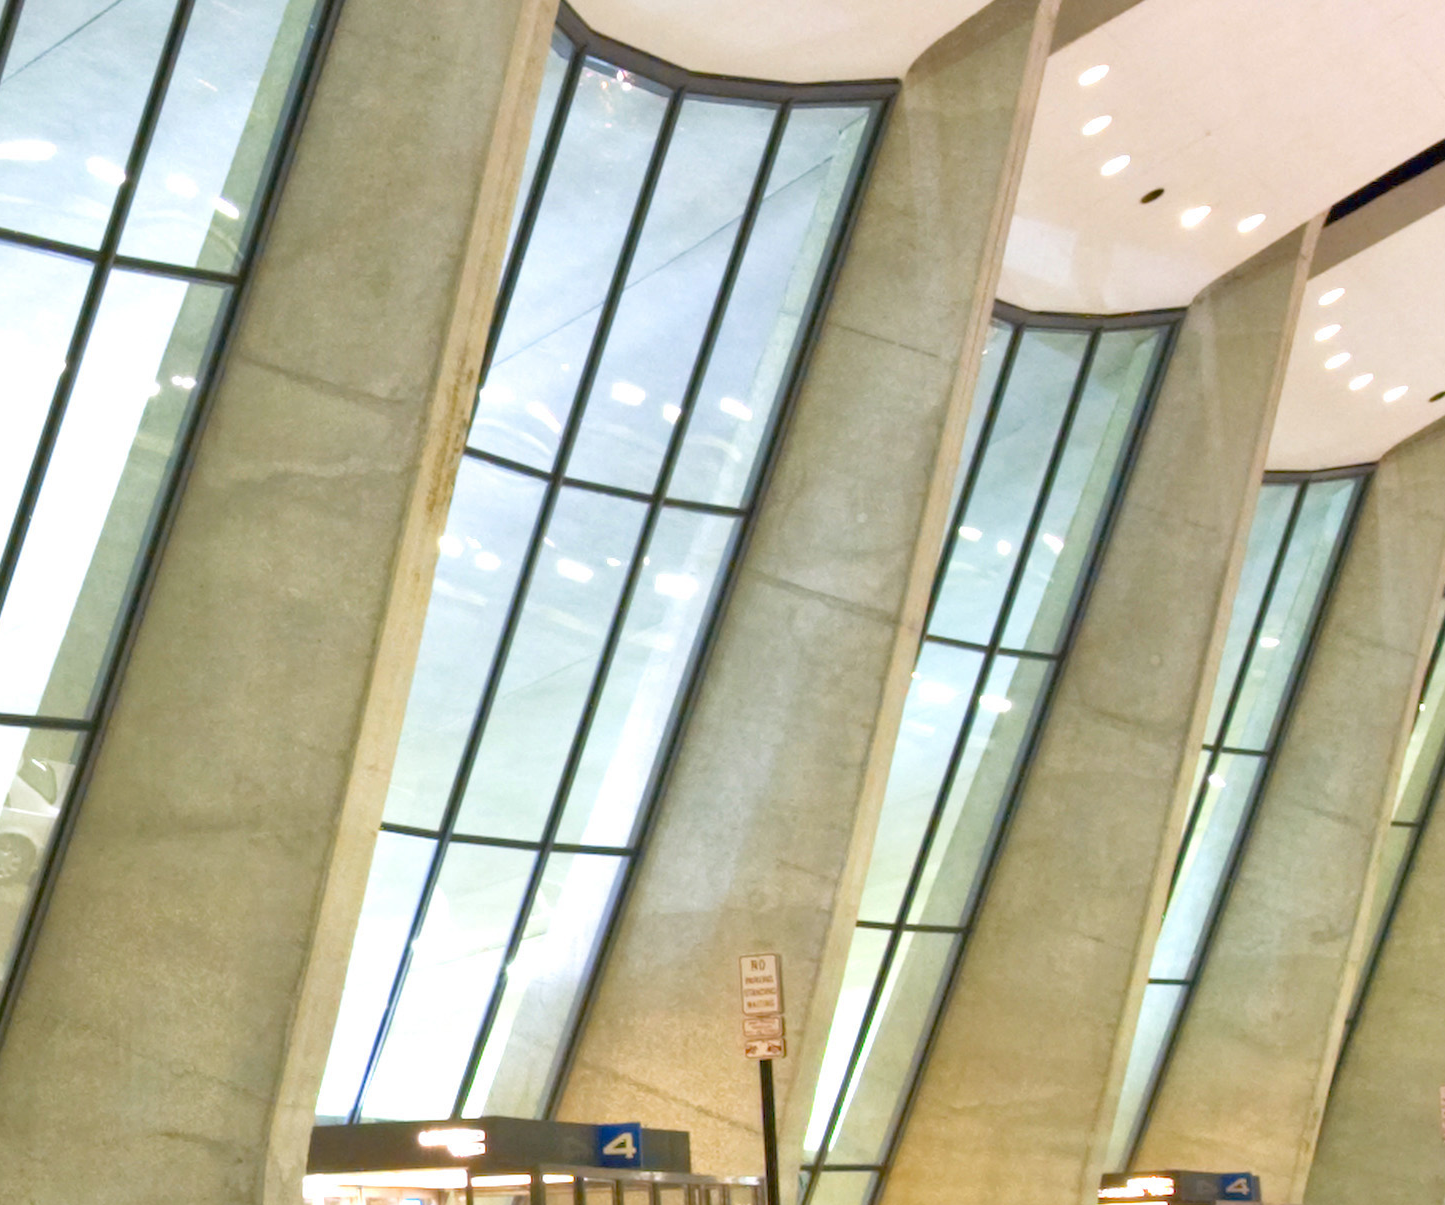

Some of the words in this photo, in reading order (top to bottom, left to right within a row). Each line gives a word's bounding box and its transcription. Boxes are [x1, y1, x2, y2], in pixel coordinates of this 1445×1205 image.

[751, 959, 766, 971] NO
[603, 1132, 637, 1159] 4
[1225, 1178, 1250, 1195] 4
